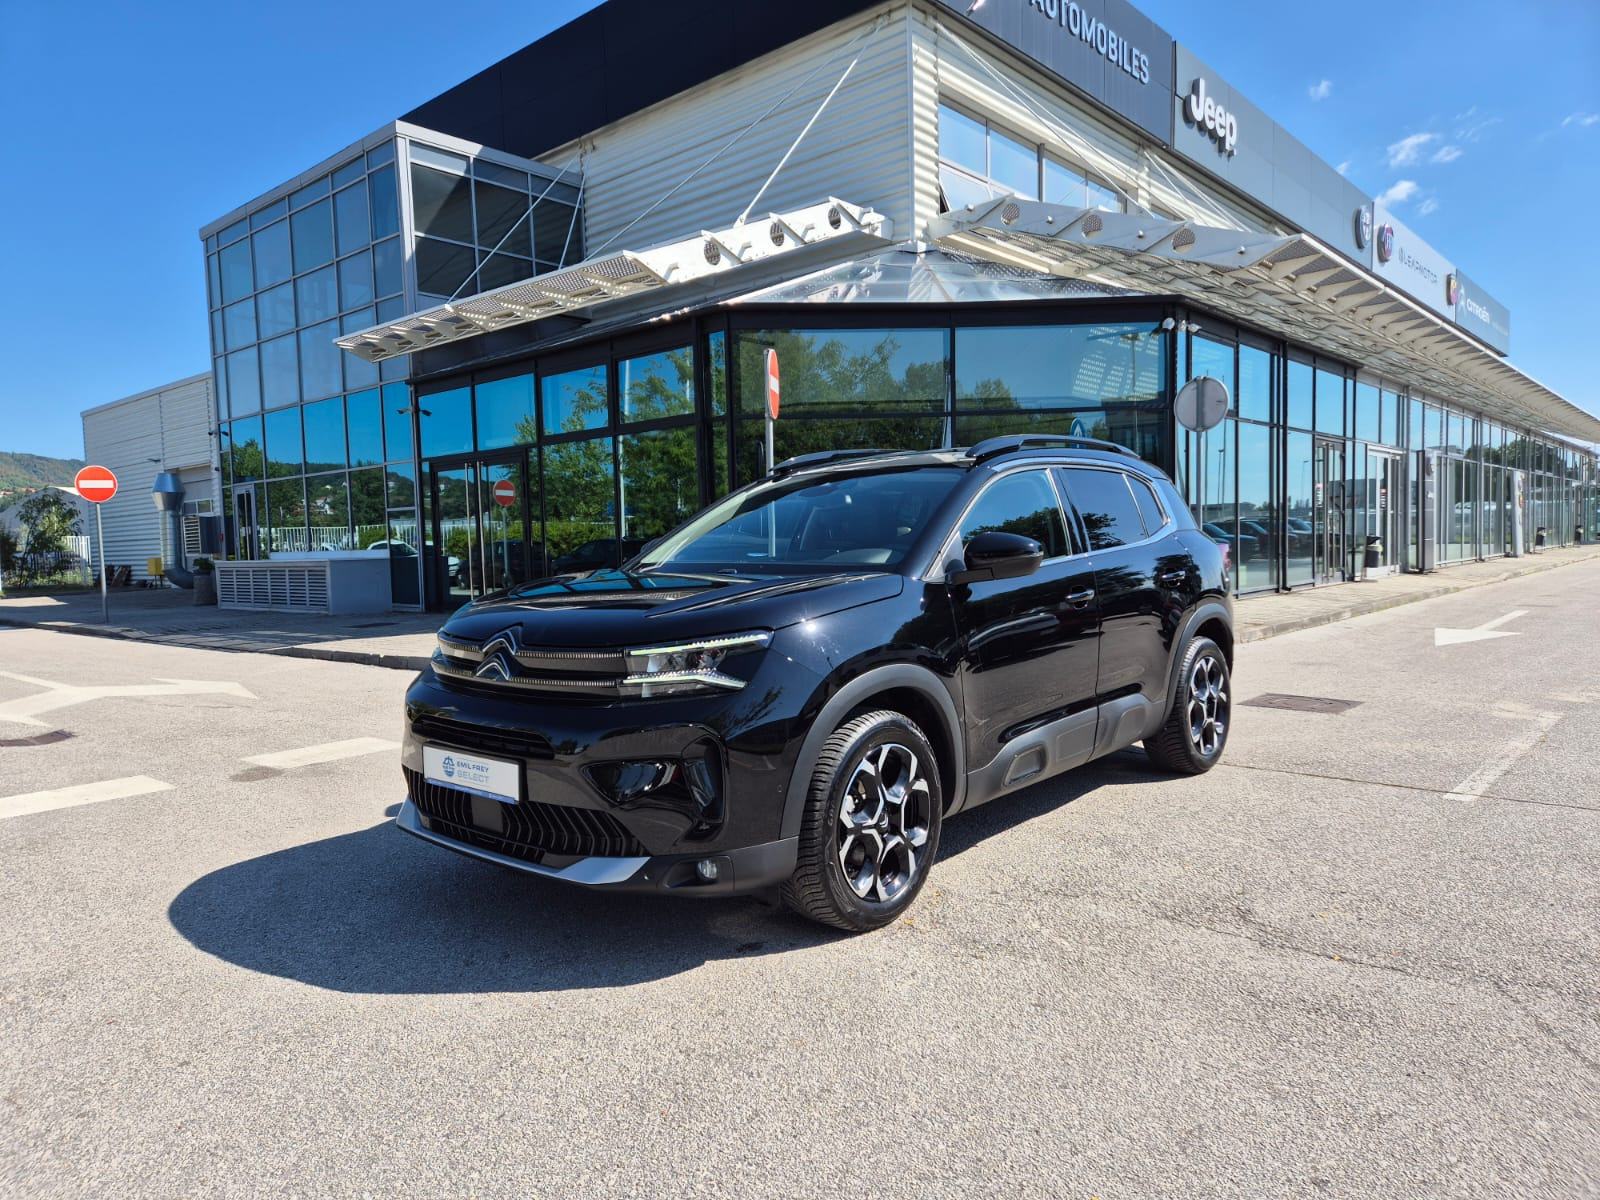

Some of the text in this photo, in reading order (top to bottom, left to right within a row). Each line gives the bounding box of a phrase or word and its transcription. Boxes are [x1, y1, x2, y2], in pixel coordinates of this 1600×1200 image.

[1190, 78, 1237, 150] Jeep
[457, 761, 488, 773] EMIL FREY
[457, 770, 488, 783] SELECT
